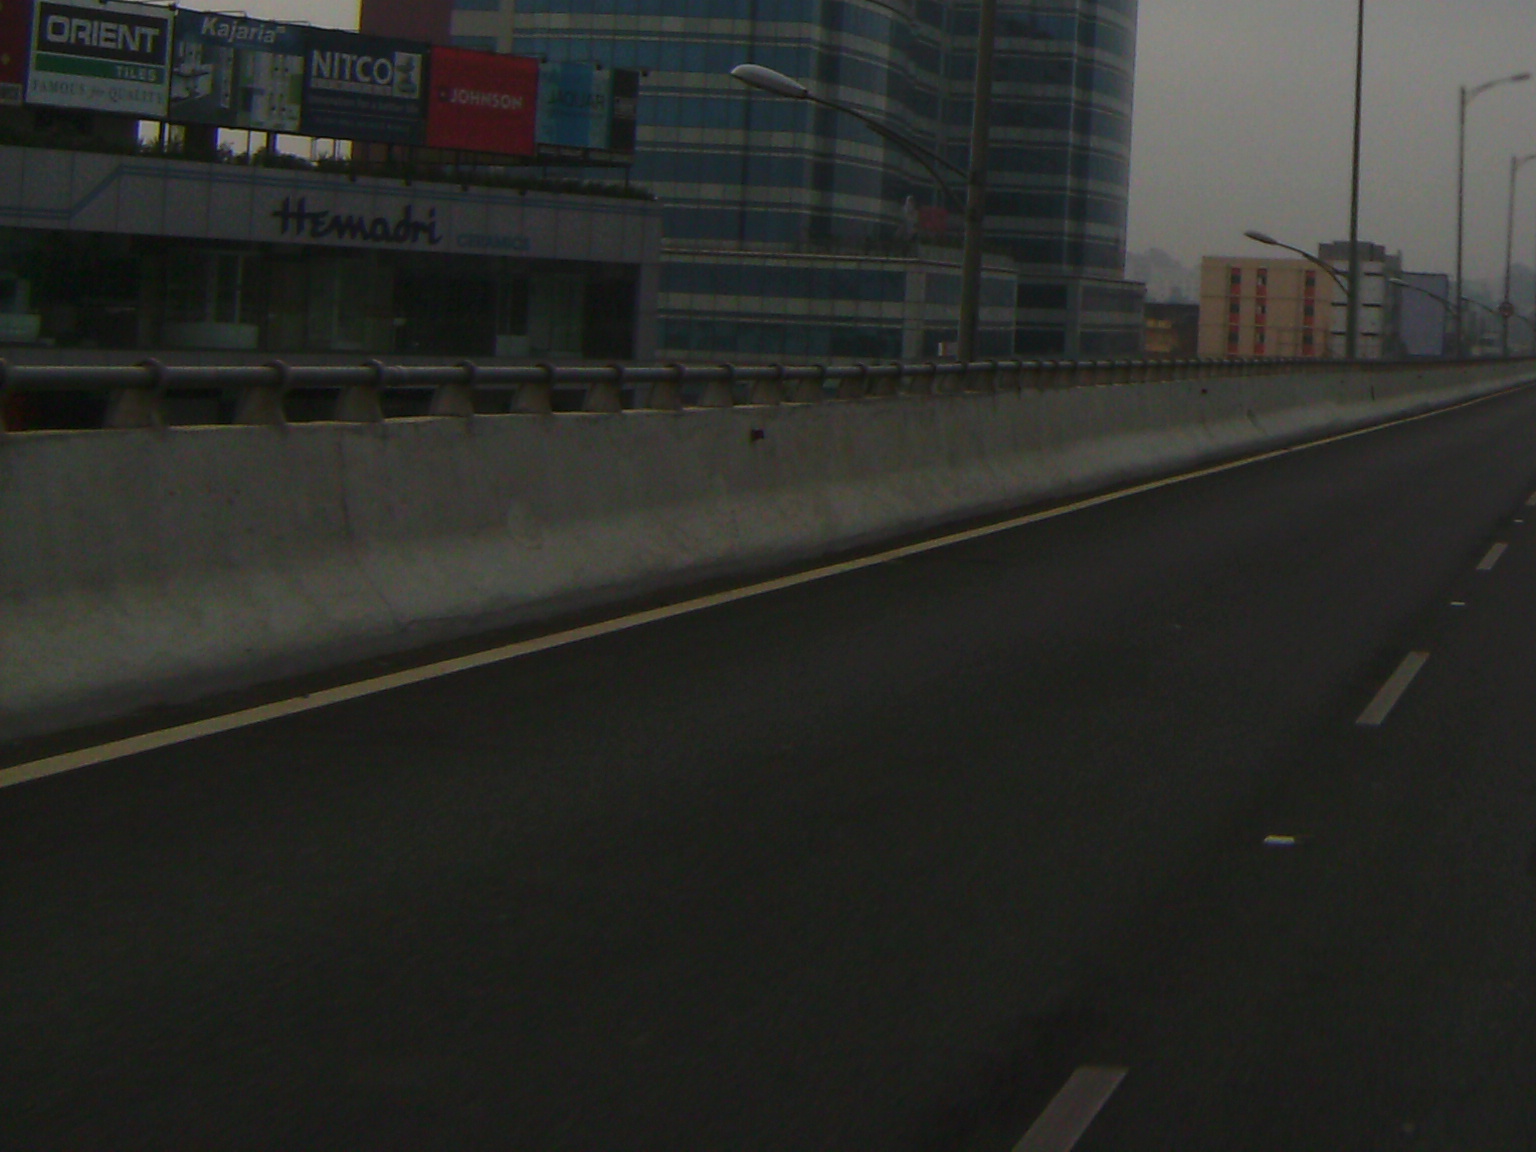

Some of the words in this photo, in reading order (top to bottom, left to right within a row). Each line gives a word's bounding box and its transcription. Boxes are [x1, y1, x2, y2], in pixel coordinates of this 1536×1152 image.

[46, 14, 161, 54] ORIENT
[201, 16, 278, 44] Kajaria
[116, 65, 159, 83] TILES
[311, 49, 394, 86] NITCO
[449, 88, 524, 110] JOHNSON
